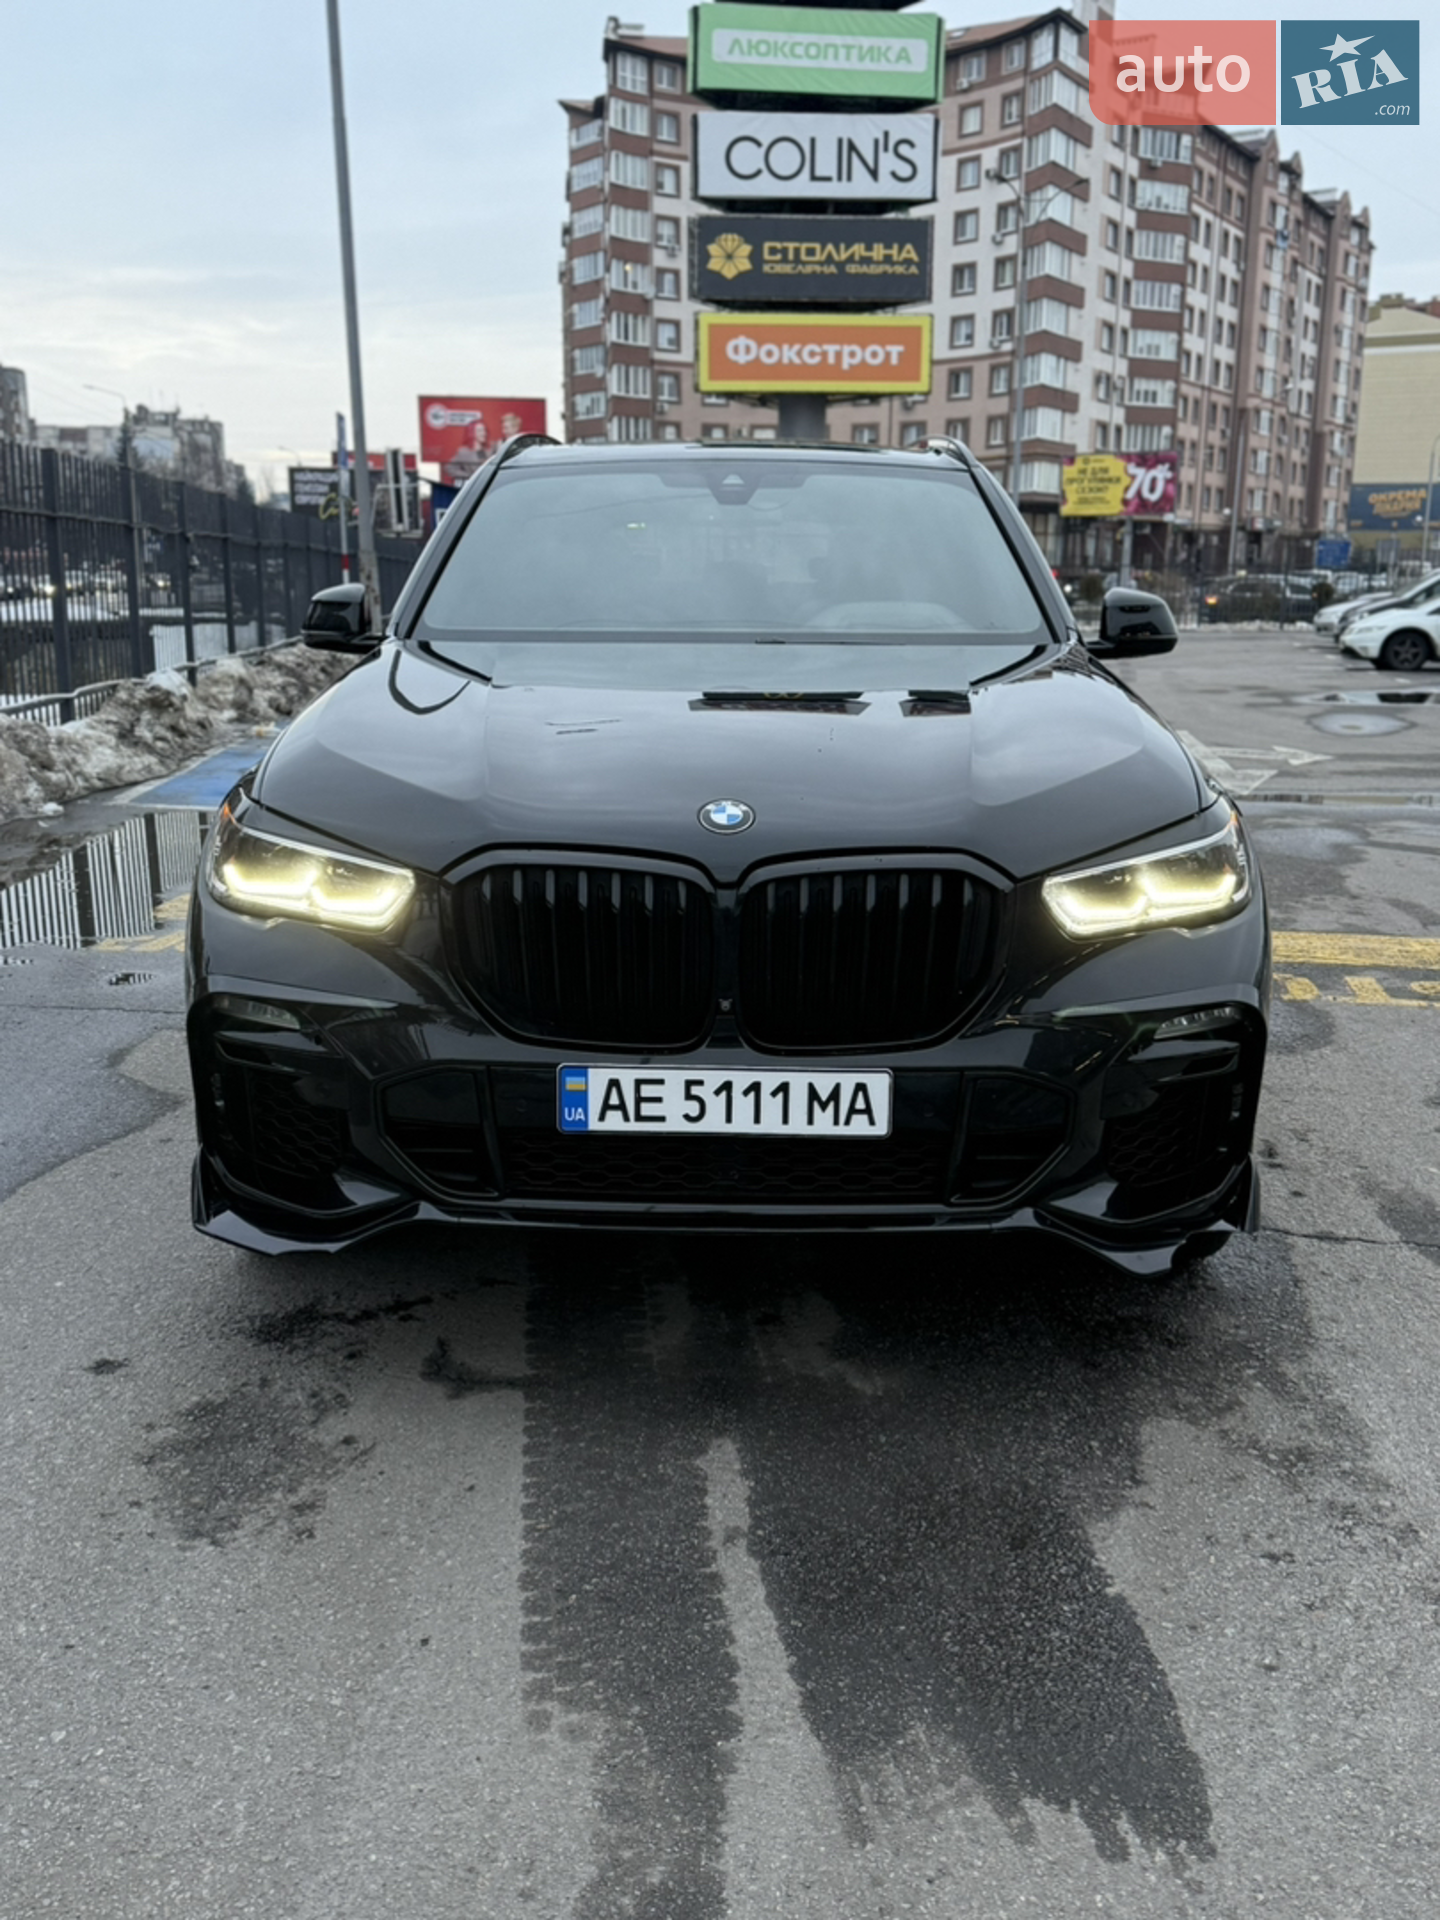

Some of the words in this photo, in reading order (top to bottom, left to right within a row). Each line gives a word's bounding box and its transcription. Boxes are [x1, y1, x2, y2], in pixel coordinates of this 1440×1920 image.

[728, 37, 912, 65] ЛЮКСОПТИКА
[725, 130, 918, 183] COLIN'S
[763, 241, 919, 262] СТОЛИЧНА
[762, 263, 838, 275] ЮВЕЛІРНА
[845, 264, 919, 275] ФАБРИКА
[726, 335, 905, 370] Фокстрот
[564, 1107, 586, 1122] UA
[598, 1078, 667, 1123] AE
[682, 1079, 791, 1126] 5111
[806, 1081, 877, 1127] MA
